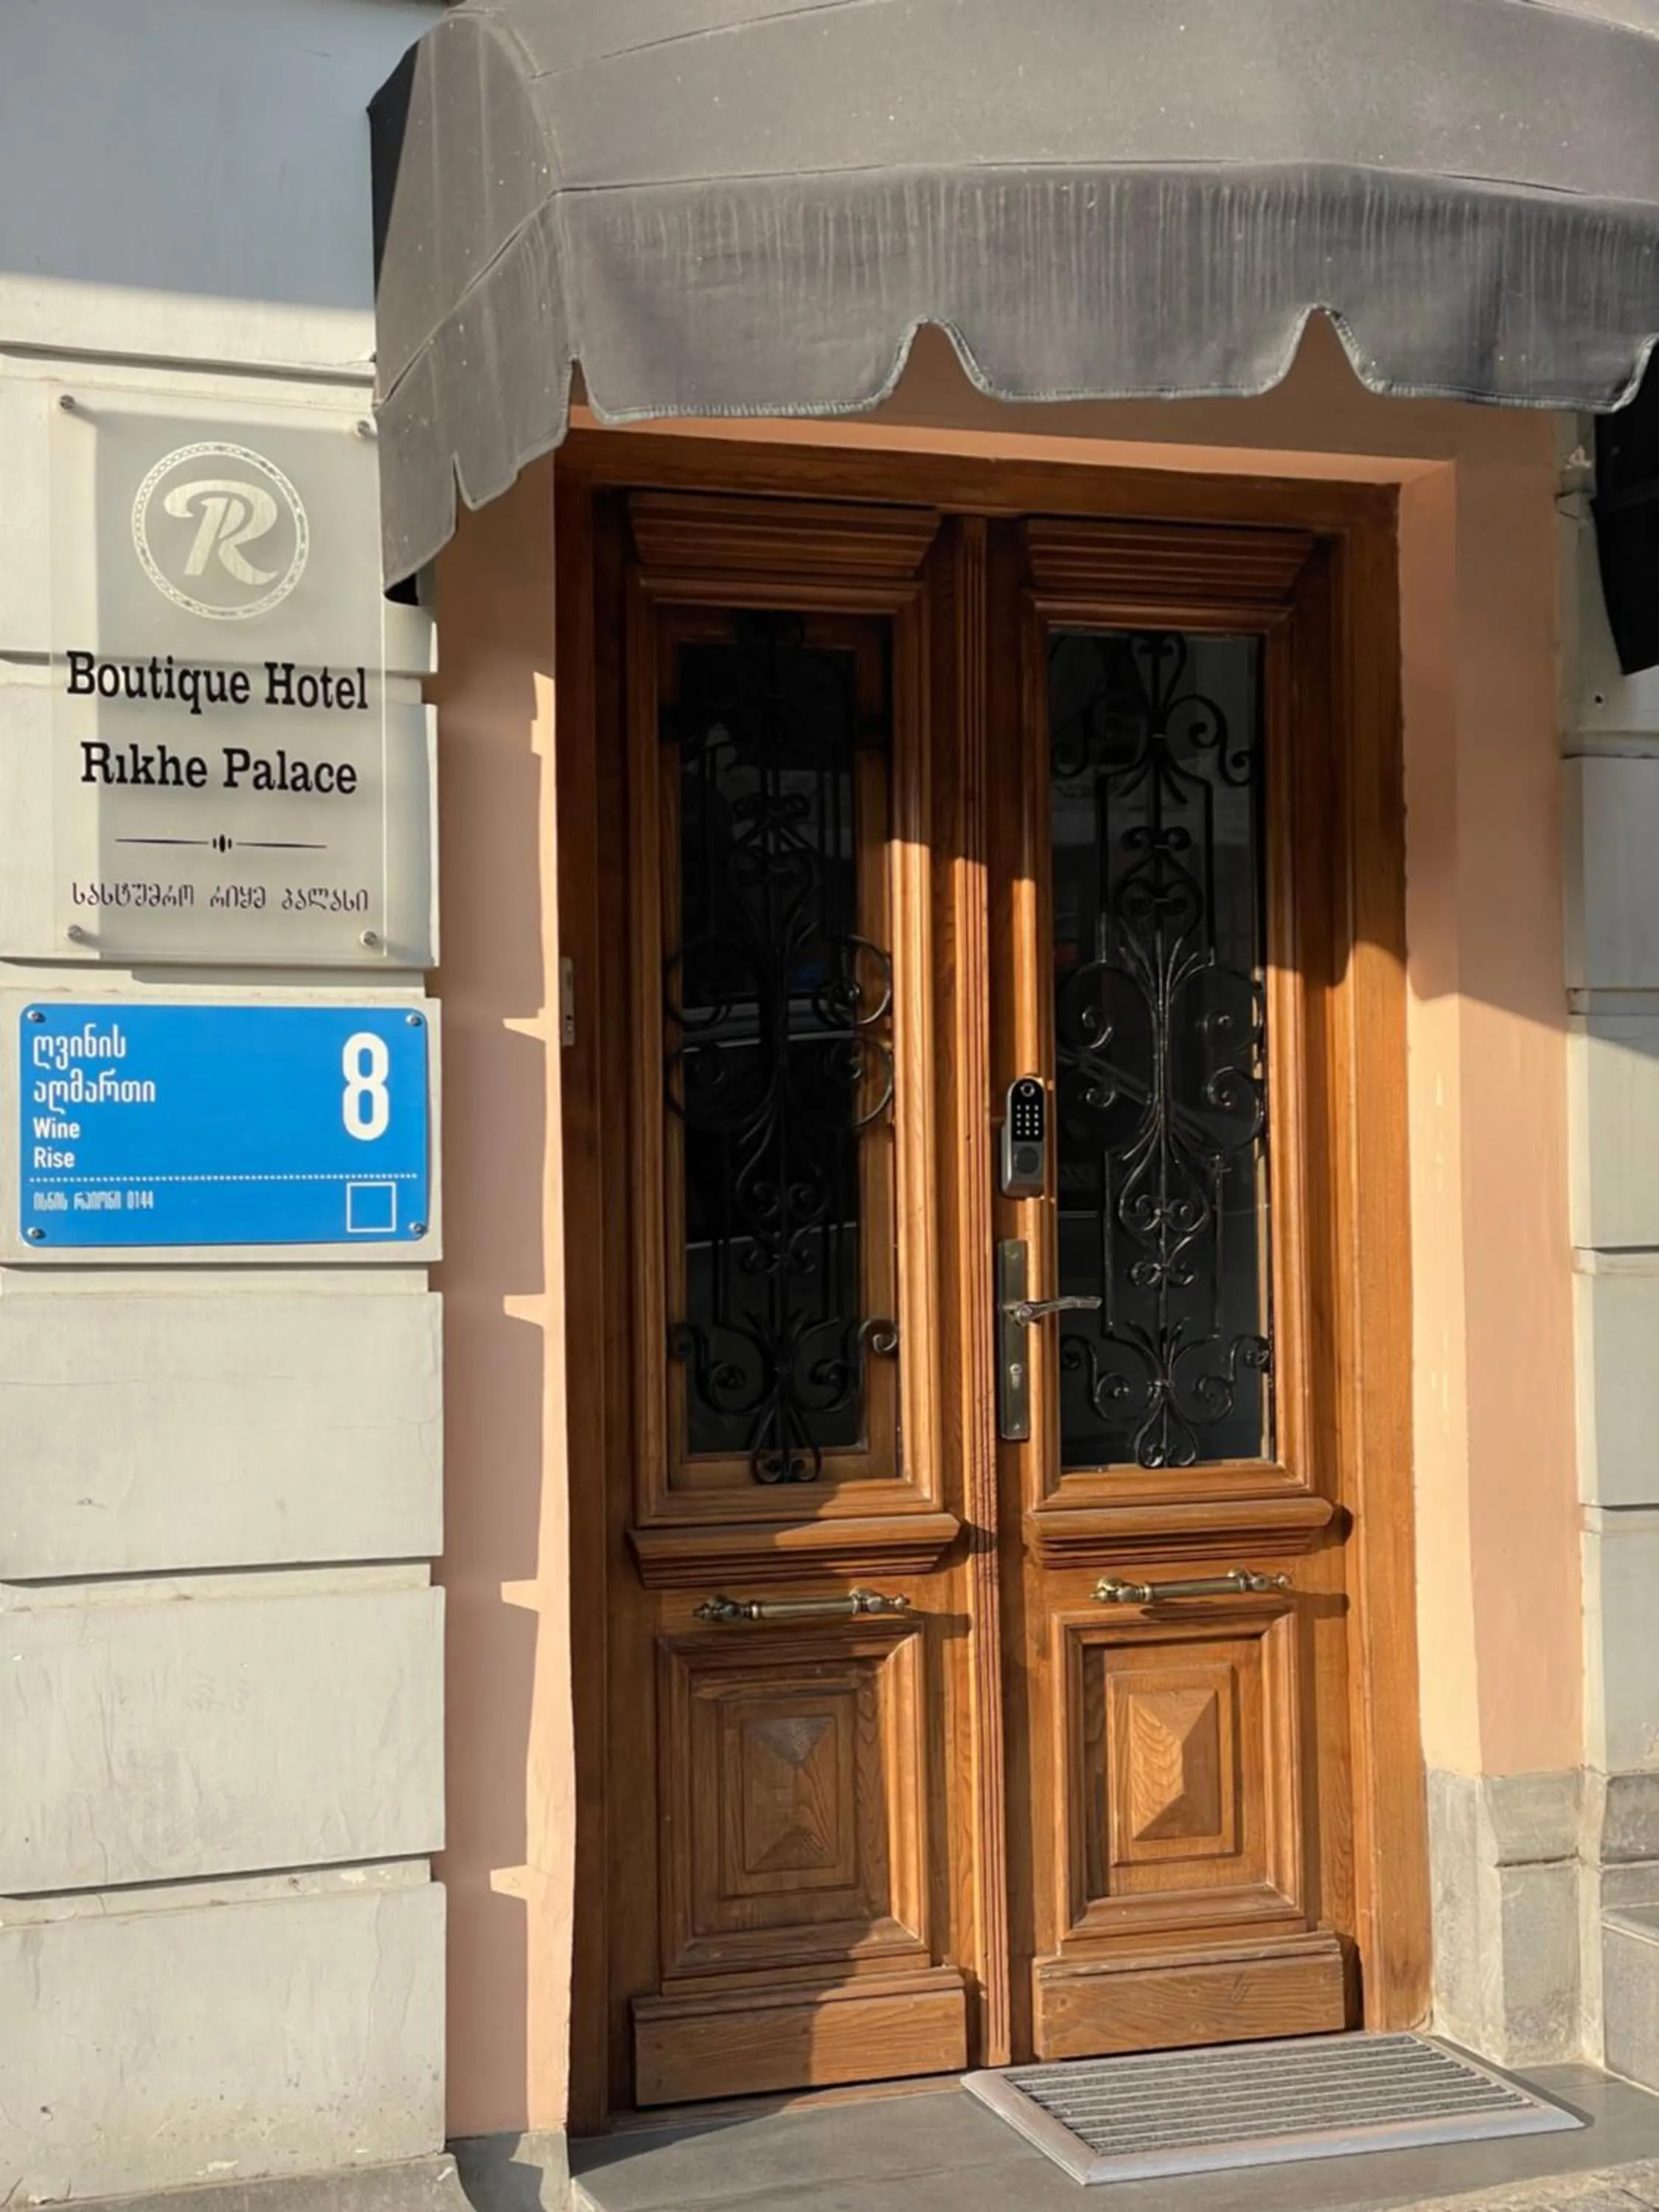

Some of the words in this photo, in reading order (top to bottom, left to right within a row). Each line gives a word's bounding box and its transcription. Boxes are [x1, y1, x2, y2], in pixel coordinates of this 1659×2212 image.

[66, 650, 251, 714] Boutique
[264, 661, 369, 709] Hotel
[222, 748, 358, 794] Palace
[72, 881, 195, 908] სასტუმრო
[209, 884, 266, 909] რიყე
[281, 887, 369, 912] პალასი
[33, 1023, 126, 1071] ღვინის
[33, 1068, 156, 1115] აღმართი
[342, 1032, 389, 1141] 8
[33, 1117, 80, 1139] Wine
[33, 1147, 75, 1169] Rise
[127, 1189, 154, 1210] 0144
